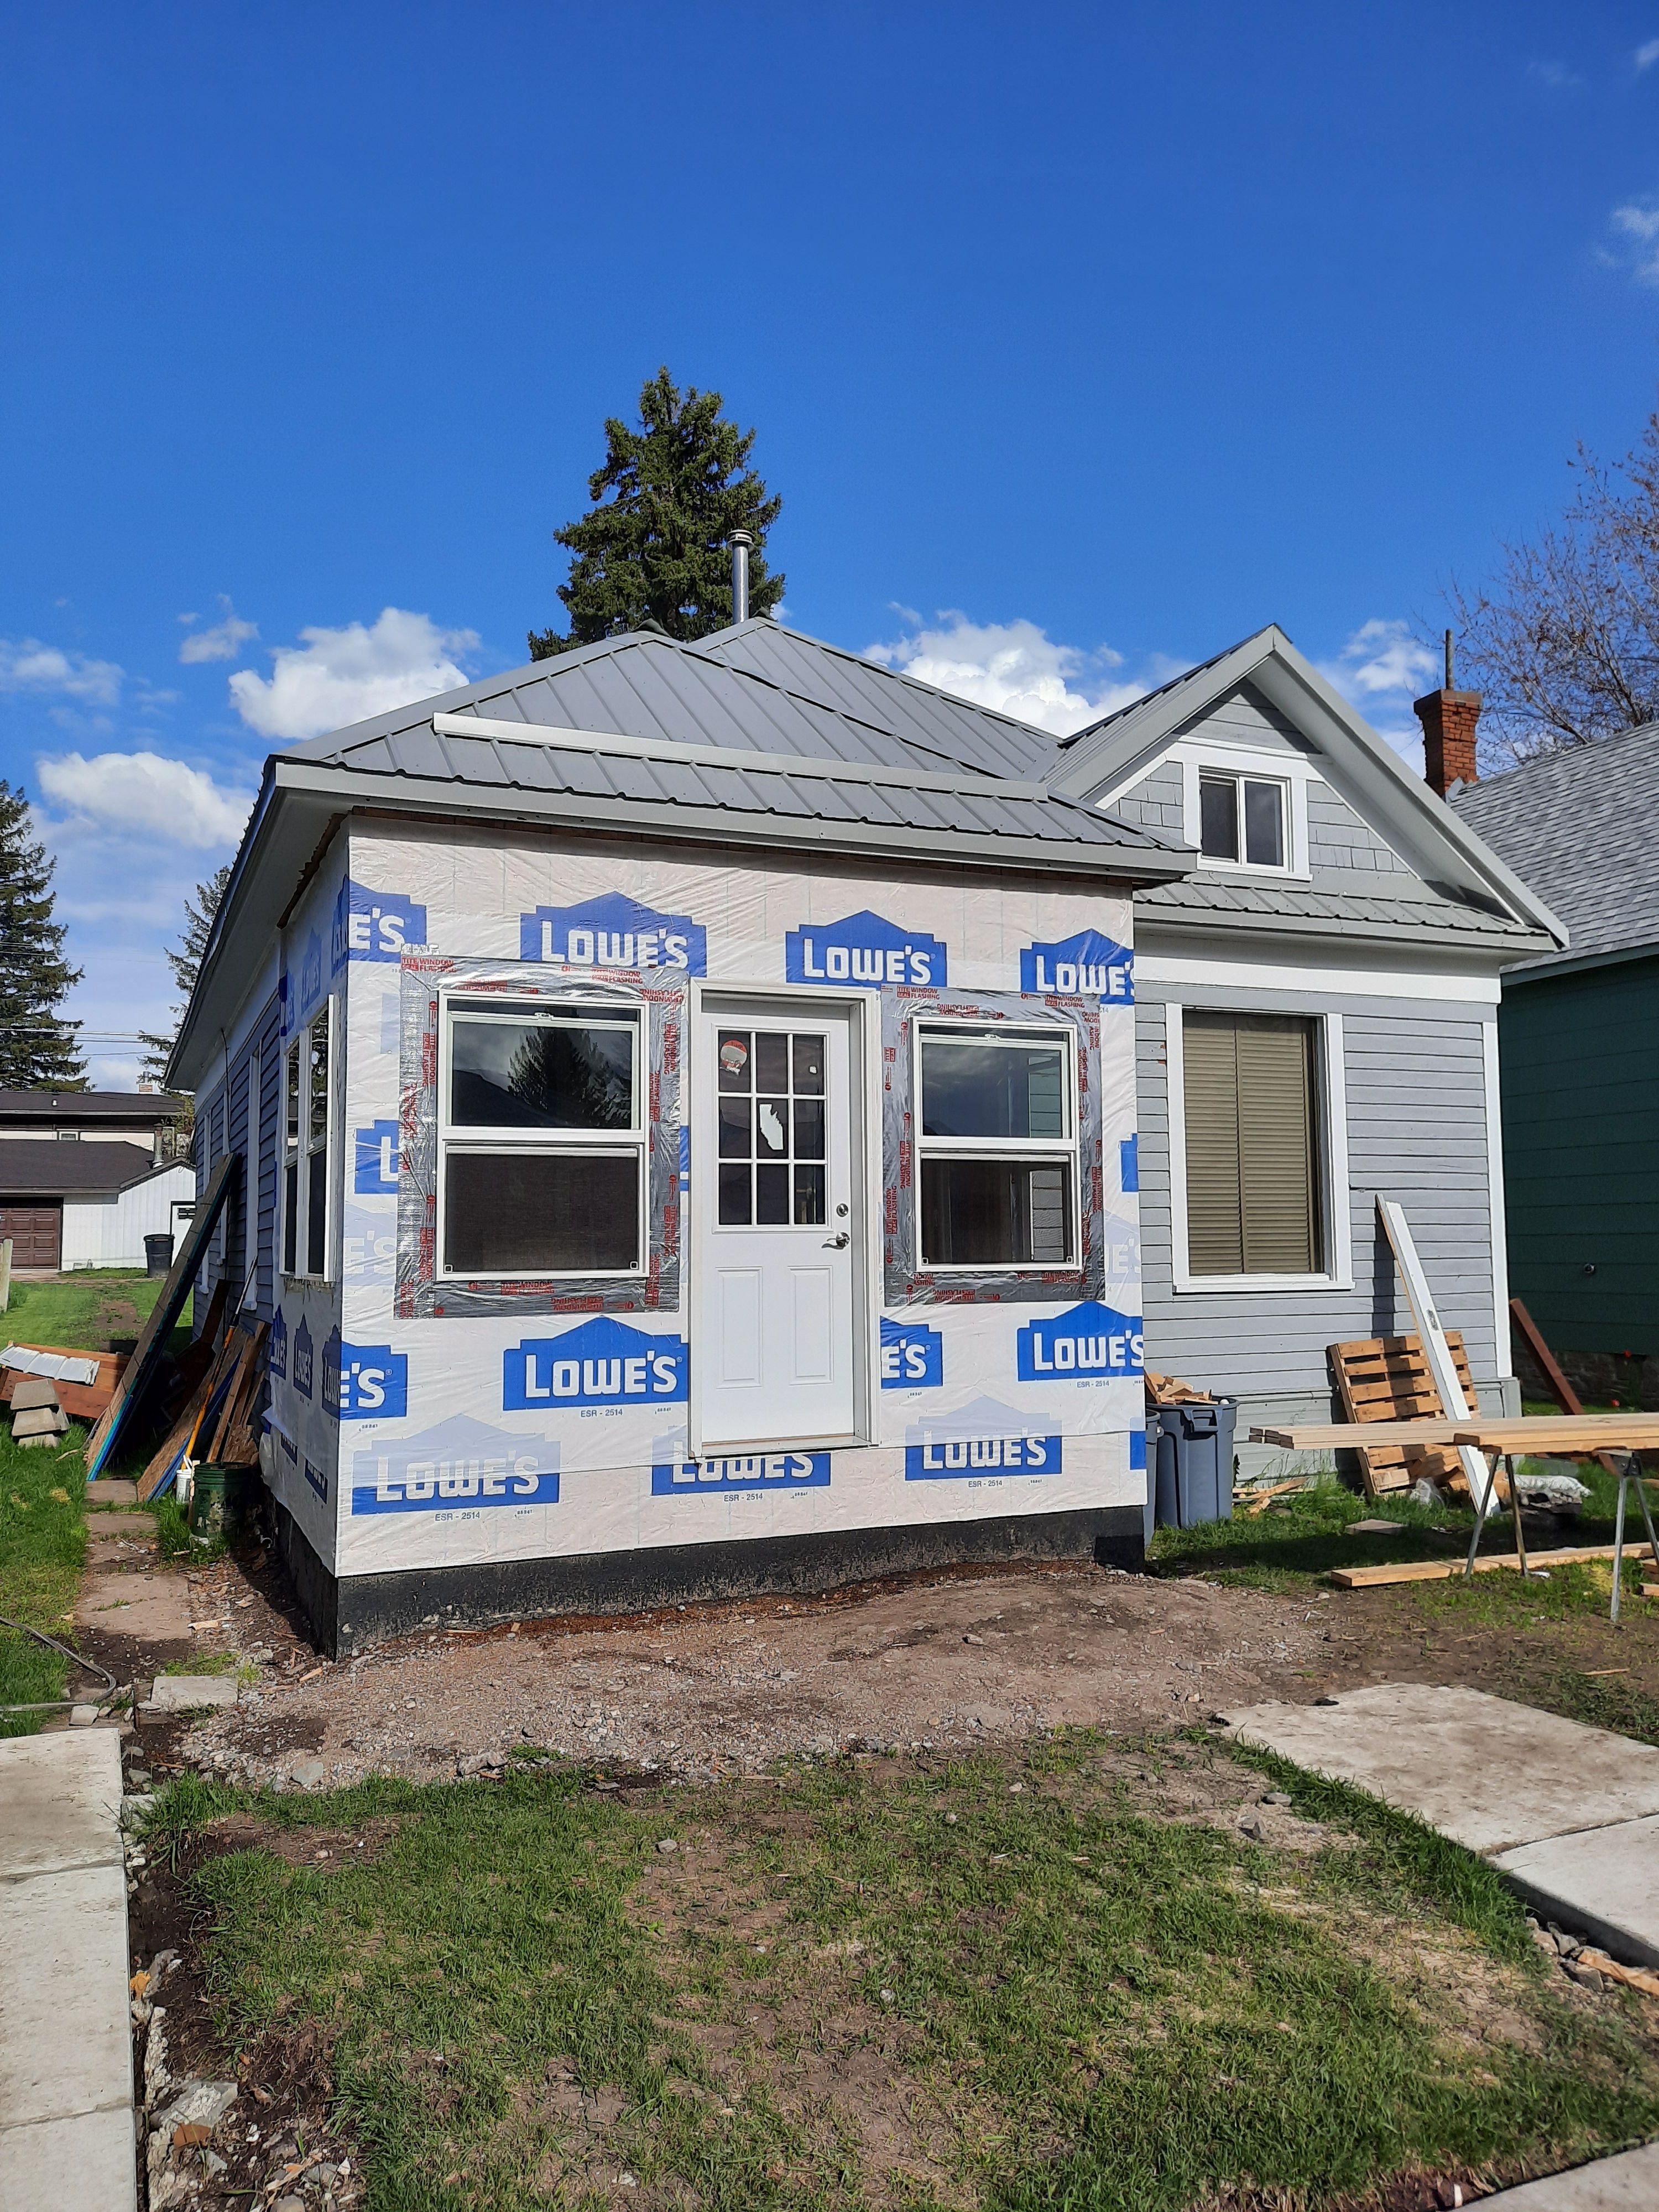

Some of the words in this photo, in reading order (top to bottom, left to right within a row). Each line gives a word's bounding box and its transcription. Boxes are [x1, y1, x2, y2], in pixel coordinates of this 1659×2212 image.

[420, 958, 454, 966] WINDOW
[542, 920, 688, 968] LOWE'S
[804, 938, 931, 984] LOWE'S
[1034, 1330, 1144, 1371] LOWE'S
[525, 1350, 677, 1398] LOWE'S
[924, 1427, 1047, 1469] LOWE'S
[377, 1450, 540, 1502] LOWE'S
[747, 1493, 763, 1501] 2514
[435, 1513, 453, 1521] ESR
[461, 1511, 480, 1520] 2514
